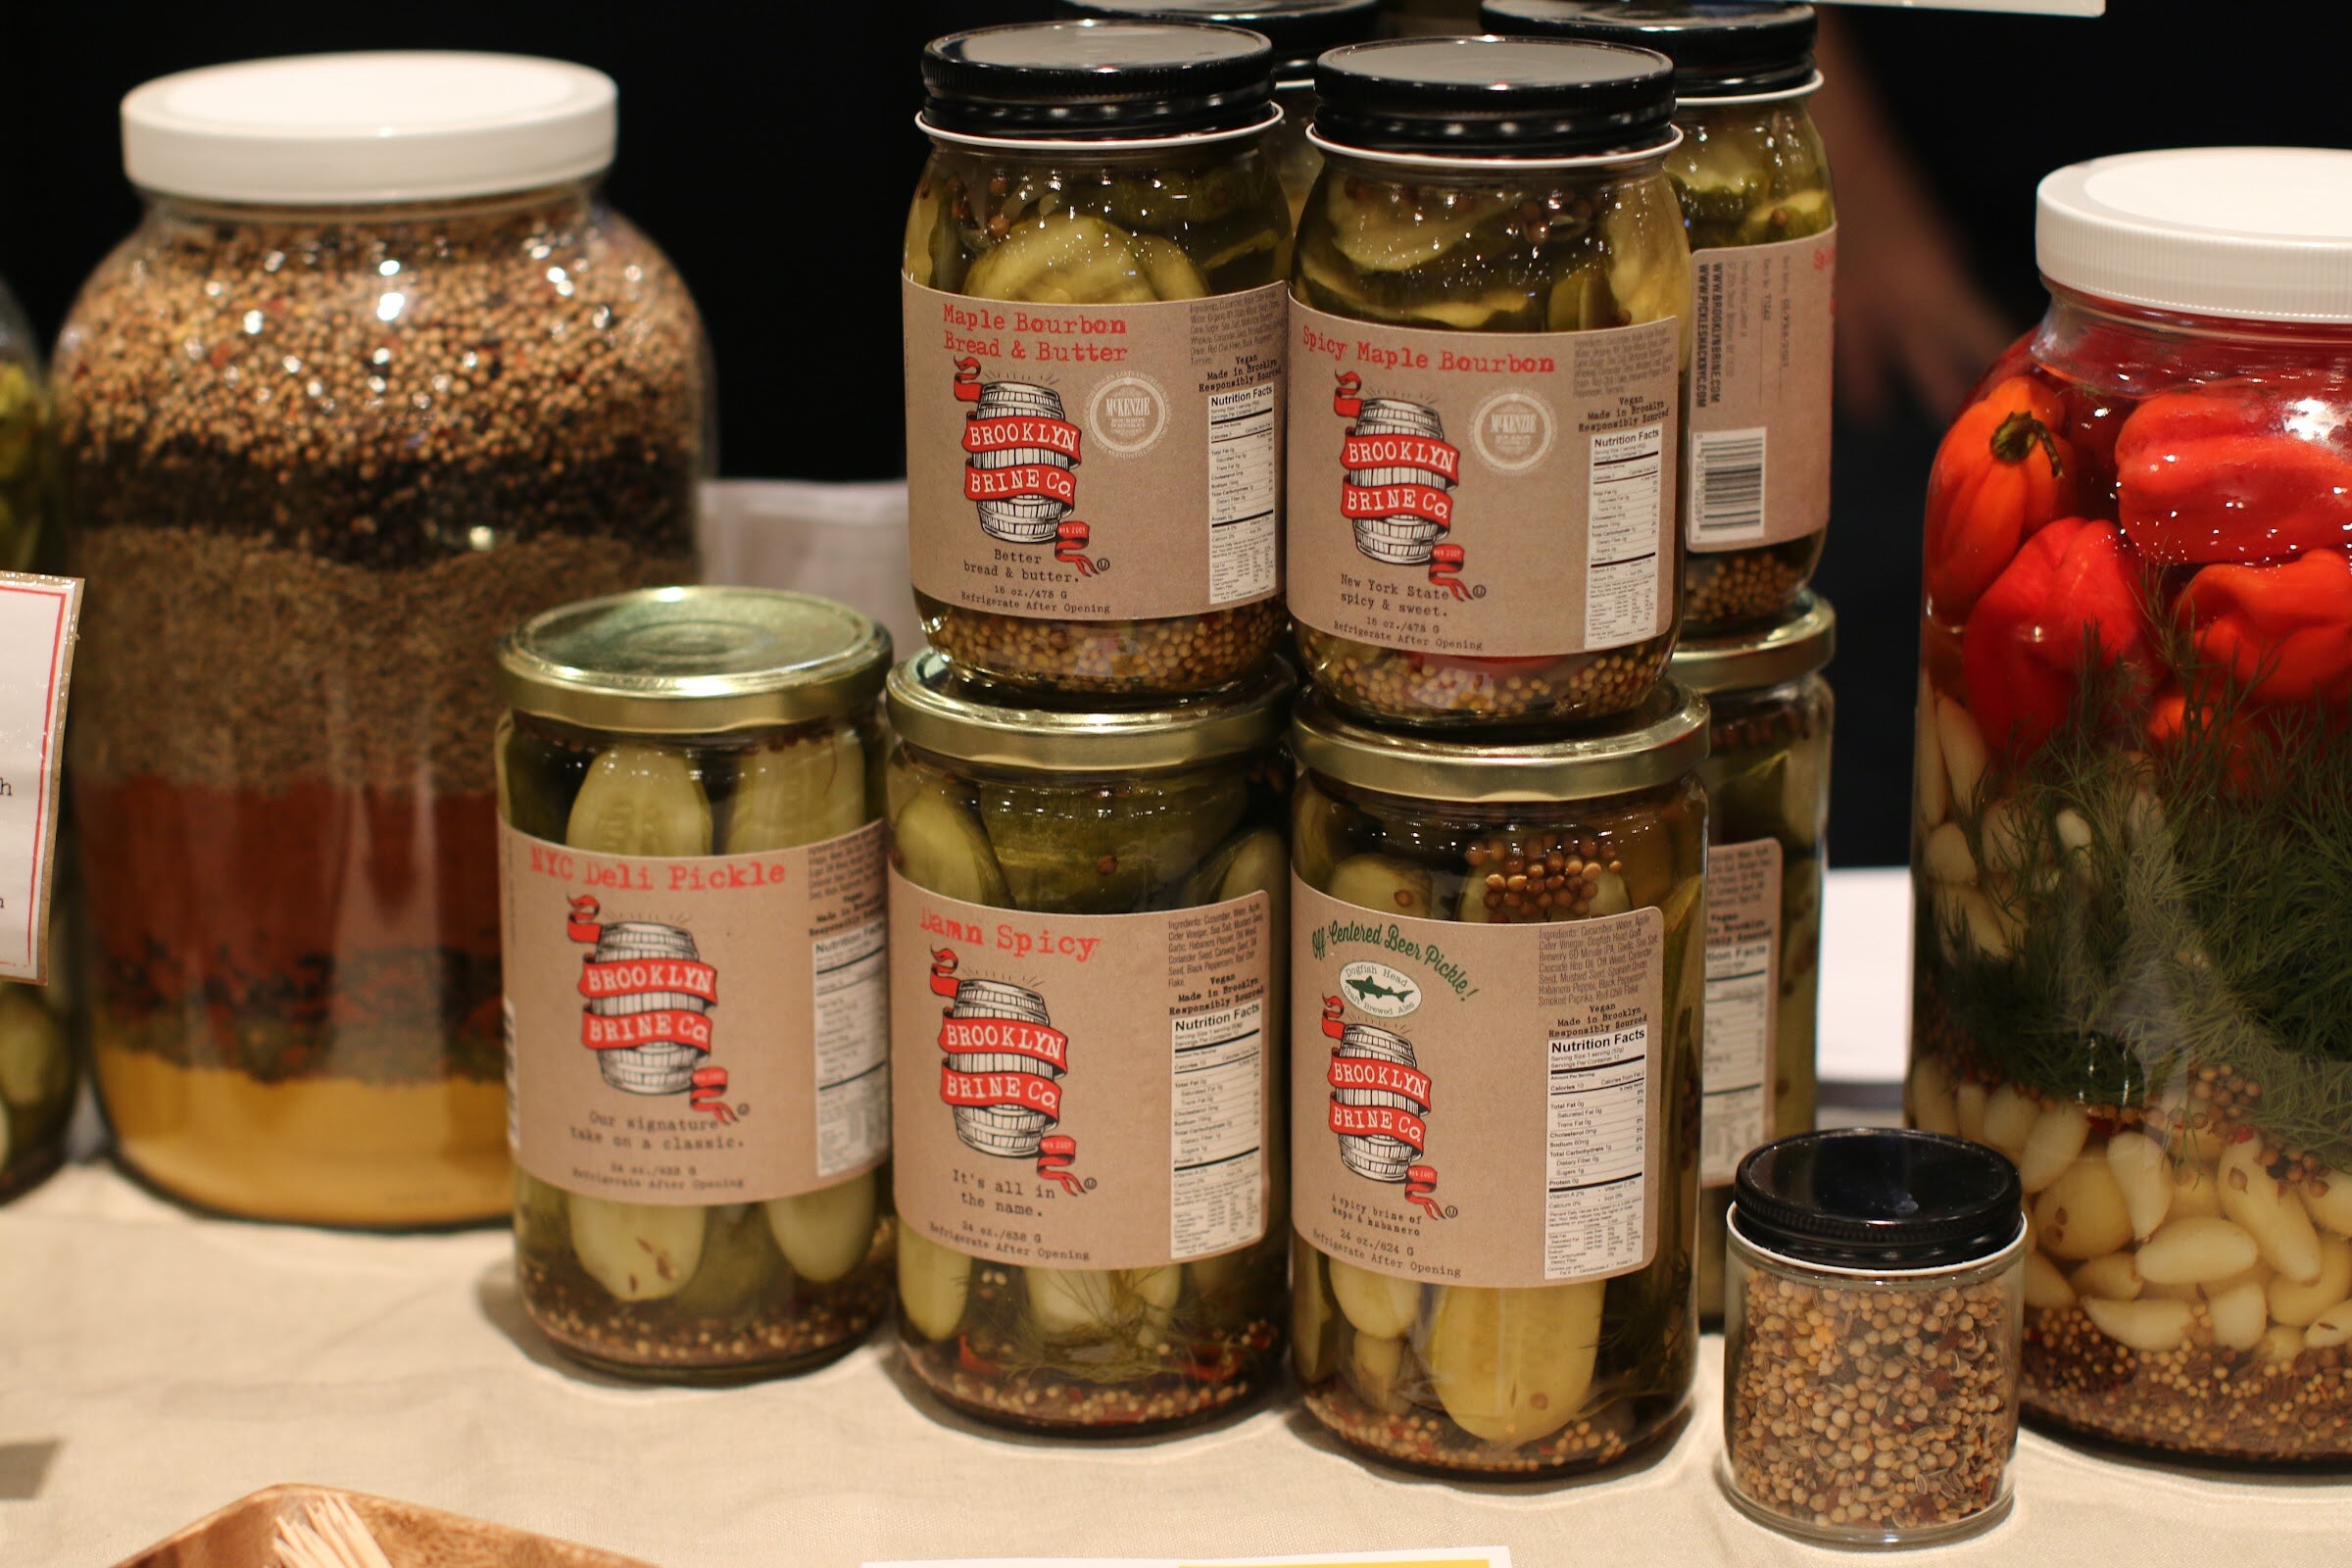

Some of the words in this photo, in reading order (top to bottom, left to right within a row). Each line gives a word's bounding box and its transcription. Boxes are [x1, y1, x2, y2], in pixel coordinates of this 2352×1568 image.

[943, 304, 1005, 330] Maple
[1014, 313, 1126, 334] Bourbon
[944, 330, 1002, 358] Bread
[1011, 341, 1026, 360] &
[1036, 343, 1127, 362] Butter
[1711, 263, 1723, 403] WWW.BROOKLYNBRINE.COM
[1235, 354, 1258, 366] Vegan
[1303, 325, 1347, 361] Spicy
[1357, 341, 1429, 370] Maple
[1439, 350, 1555, 373] Bourbon
[1207, 370, 1228, 380] Made
[1235, 367, 1244, 376] in
[1247, 359, 1278, 371] Brooklyn
[1199, 375, 1253, 392] Responsibly
[1211, 390, 1250, 407] Nutrition
[1252, 385, 1272, 399] Facts
[1588, 411, 1610, 420] Made
[1617, 408, 1627, 416] in
[1631, 401, 1664, 414] Brooklyn
[1619, 396, 1642, 406] Vegan
[1578, 416, 1638, 432] Responsibly
[1642, 408, 1669, 423] Sourced
[970, 422, 1077, 452] BROOKLYN
[1594, 435, 1636, 448] Nutrition
[1639, 429, 1658, 441] Facts
[1348, 440, 1455, 473] BROOKLYN
[970, 468, 1040, 493] BRINE
[1047, 472, 1071, 497] Co.
[1348, 488, 1415, 511] BRINE
[1423, 493, 1447, 518] Co.
[995, 549, 1042, 564] Better
[964, 560, 998, 576] bread
[1022, 568, 1079, 582] butter.
[1341, 573, 1360, 587] New
[1368, 579, 1399, 596] York
[1407, 585, 1448, 600] State
[961, 591, 1020, 609] Refrigerate
[1026, 602, 1057, 612] After
[1064, 604, 1110, 613] Opening
[1341, 592, 1374, 609] spicy
[1383, 600, 1391, 612] &
[1399, 604, 1447, 616] sweet.
[1334, 620, 1392, 641] Refrigerate
[1397, 634, 1428, 646] After
[1436, 637, 1483, 651] Opening
[529, 846, 573, 880] NYC
[584, 862, 654, 891] Deli
[667, 861, 786, 891] Pickle
[997, 924, 1102, 962] Spicy
[1539, 941, 1556, 951] Cider
[1539, 952, 1566, 960] Brewery
[1569, 949, 1578, 957] 60
[1582, 947, 1602, 956] Minute
[1384, 923, 1421, 960] Beer
[1424, 945, 1480, 1002] Pickle!
[587, 964, 712, 994] BROOKLYN
[1210, 974, 1235, 984] Vegan
[1345, 964, 1378, 978] Dogfish
[1384, 969, 1408, 988] Head
[1169, 1000, 1231, 1015] Responsibly
[1236, 986, 1264, 1003] Sourced
[1178, 993, 1201, 1003] Made
[1223, 978, 1258, 994] Brooklyn
[1345, 986, 1360, 1005] Craft
[1364, 1003, 1394, 1015] Brewed
[1397, 1002, 1415, 1013] Ales
[1539, 996, 1566, 1006] Smoked
[1176, 1014, 1230, 1031] Nutrition
[1234, 1004, 1260, 1019] Facts
[1558, 1017, 1580, 1027] Made
[1588, 1013, 1597, 1023] in
[1603, 1007, 1641, 1021] Brooklyn
[1590, 1004, 1615, 1013] Vegan
[588, 1014, 672, 1045] BRINE
[1548, 1023, 1610, 1038] Responsibly
[1615, 1014, 1646, 1029] Sourced
[947, 1023, 1063, 1059] BROOKLYN
[1551, 1038, 1609, 1053] Nutrition
[1614, 1029, 1644, 1045] Facts
[947, 1075, 1020, 1100] BRINE
[1029, 1081, 1056, 1108] Co.
[1334, 1062, 1427, 1100] BROOKLYN
[589, 1109, 615, 1127] Our
[627, 1116, 718, 1133] signature
[1334, 1106, 1393, 1129] BRINE
[1398, 1116, 1421, 1143] Co.
[570, 1127, 603, 1143] take
[613, 1136, 631, 1148] on
[643, 1139, 651, 1149] a
[662, 1137, 744, 1151] classic.
[1568, 1147, 1603, 1156] Carbohydrate
[953, 1169, 985, 1188] It's
[996, 1181, 1023, 1196] all
[1035, 1185, 1055, 1200] in
[962, 1192, 984, 1207] the
[996, 1202, 1043, 1217] name.
[1340, 1199, 1366, 1213] spicy
[1373, 1205, 1403, 1221] brine
[1409, 1216, 1422, 1225] of
[1333, 1205, 1352, 1219] hops
[1357, 1214, 1362, 1223] &
[1368, 1217, 1420, 1237] habanero
[930, 1223, 988, 1249] Refrigerate
[996, 1242, 1031, 1256] After
[1038, 1249, 1090, 1261] Opening
[1035, 1234, 1041, 1243] G
[1341, 1229, 1350, 1241] 24
[1407, 1247, 1414, 1256] G
[1313, 1229, 1364, 1259] Refrigerate
[1372, 1253, 1403, 1268] After
[1411, 1262, 1461, 1278] Opening
